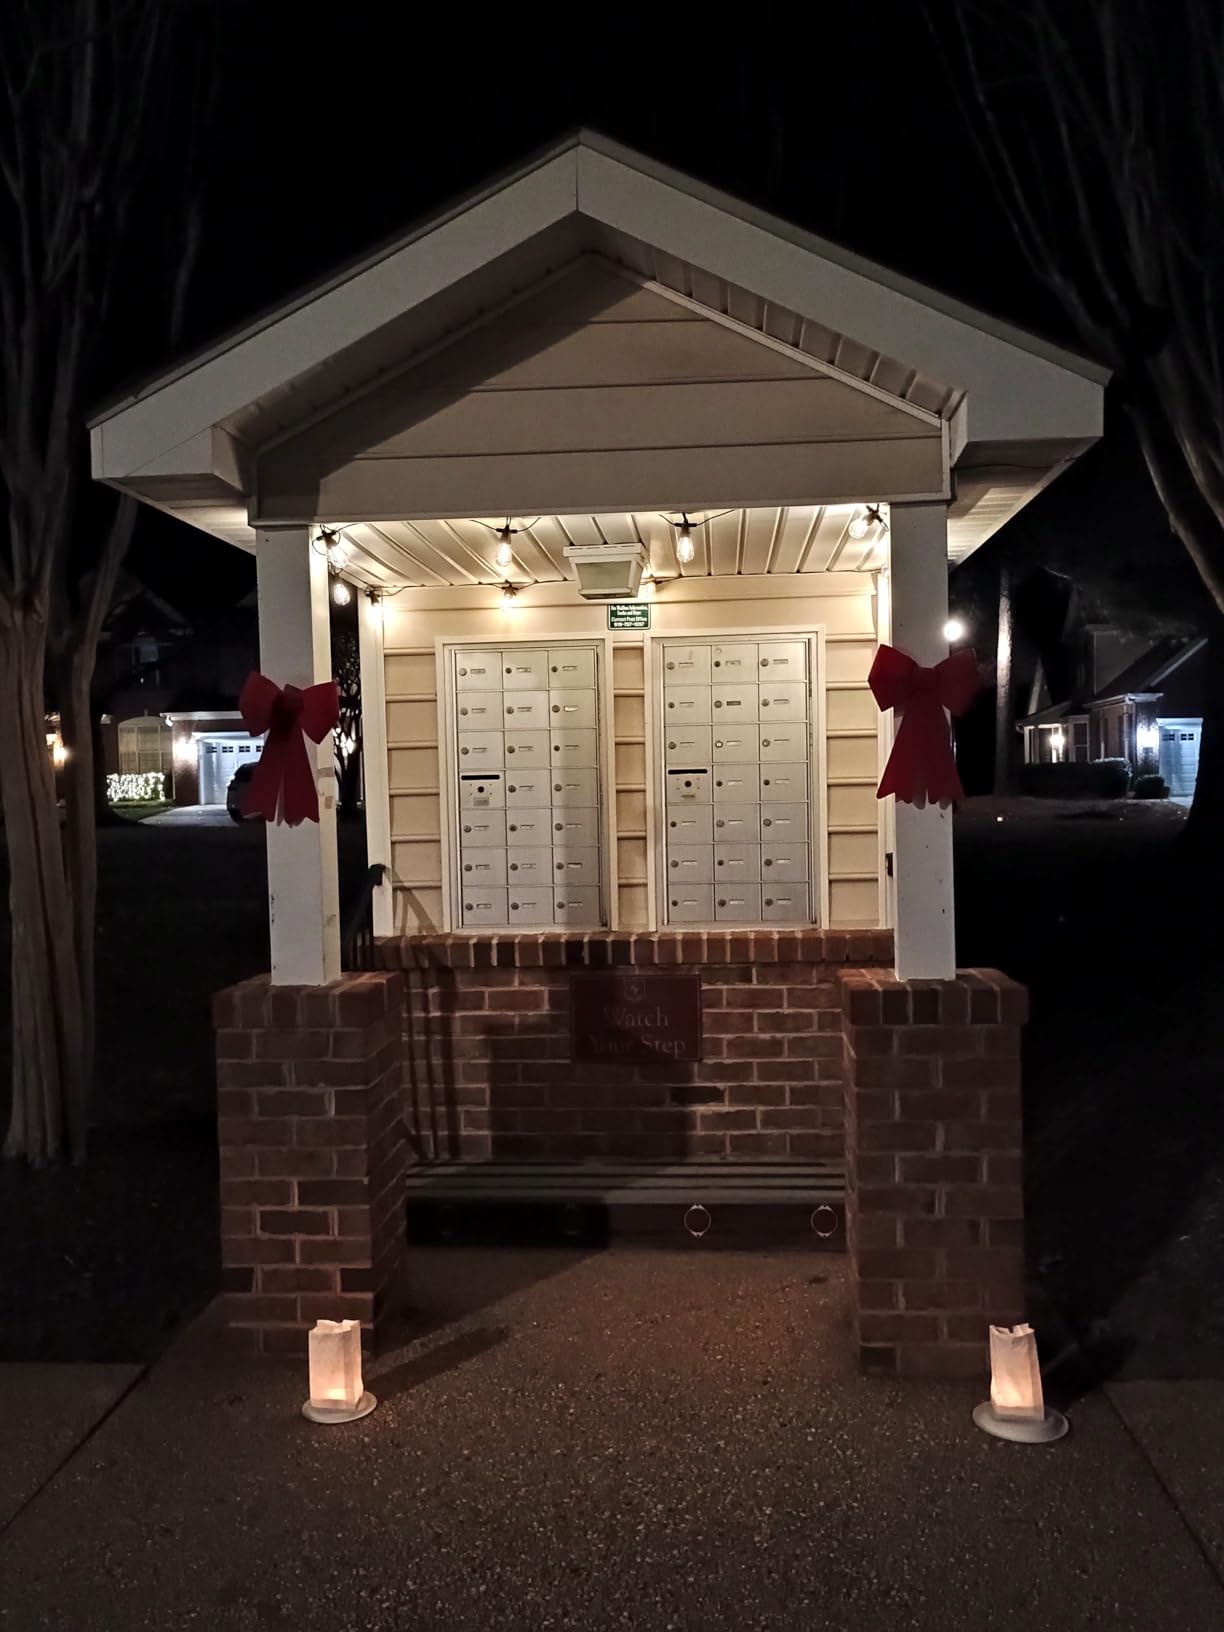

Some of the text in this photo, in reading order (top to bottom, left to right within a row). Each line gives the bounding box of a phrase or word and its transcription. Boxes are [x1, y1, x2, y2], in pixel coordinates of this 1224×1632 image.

[603, 1006, 669, 1027] Watch
[588, 1033, 687, 1061] Your Step
